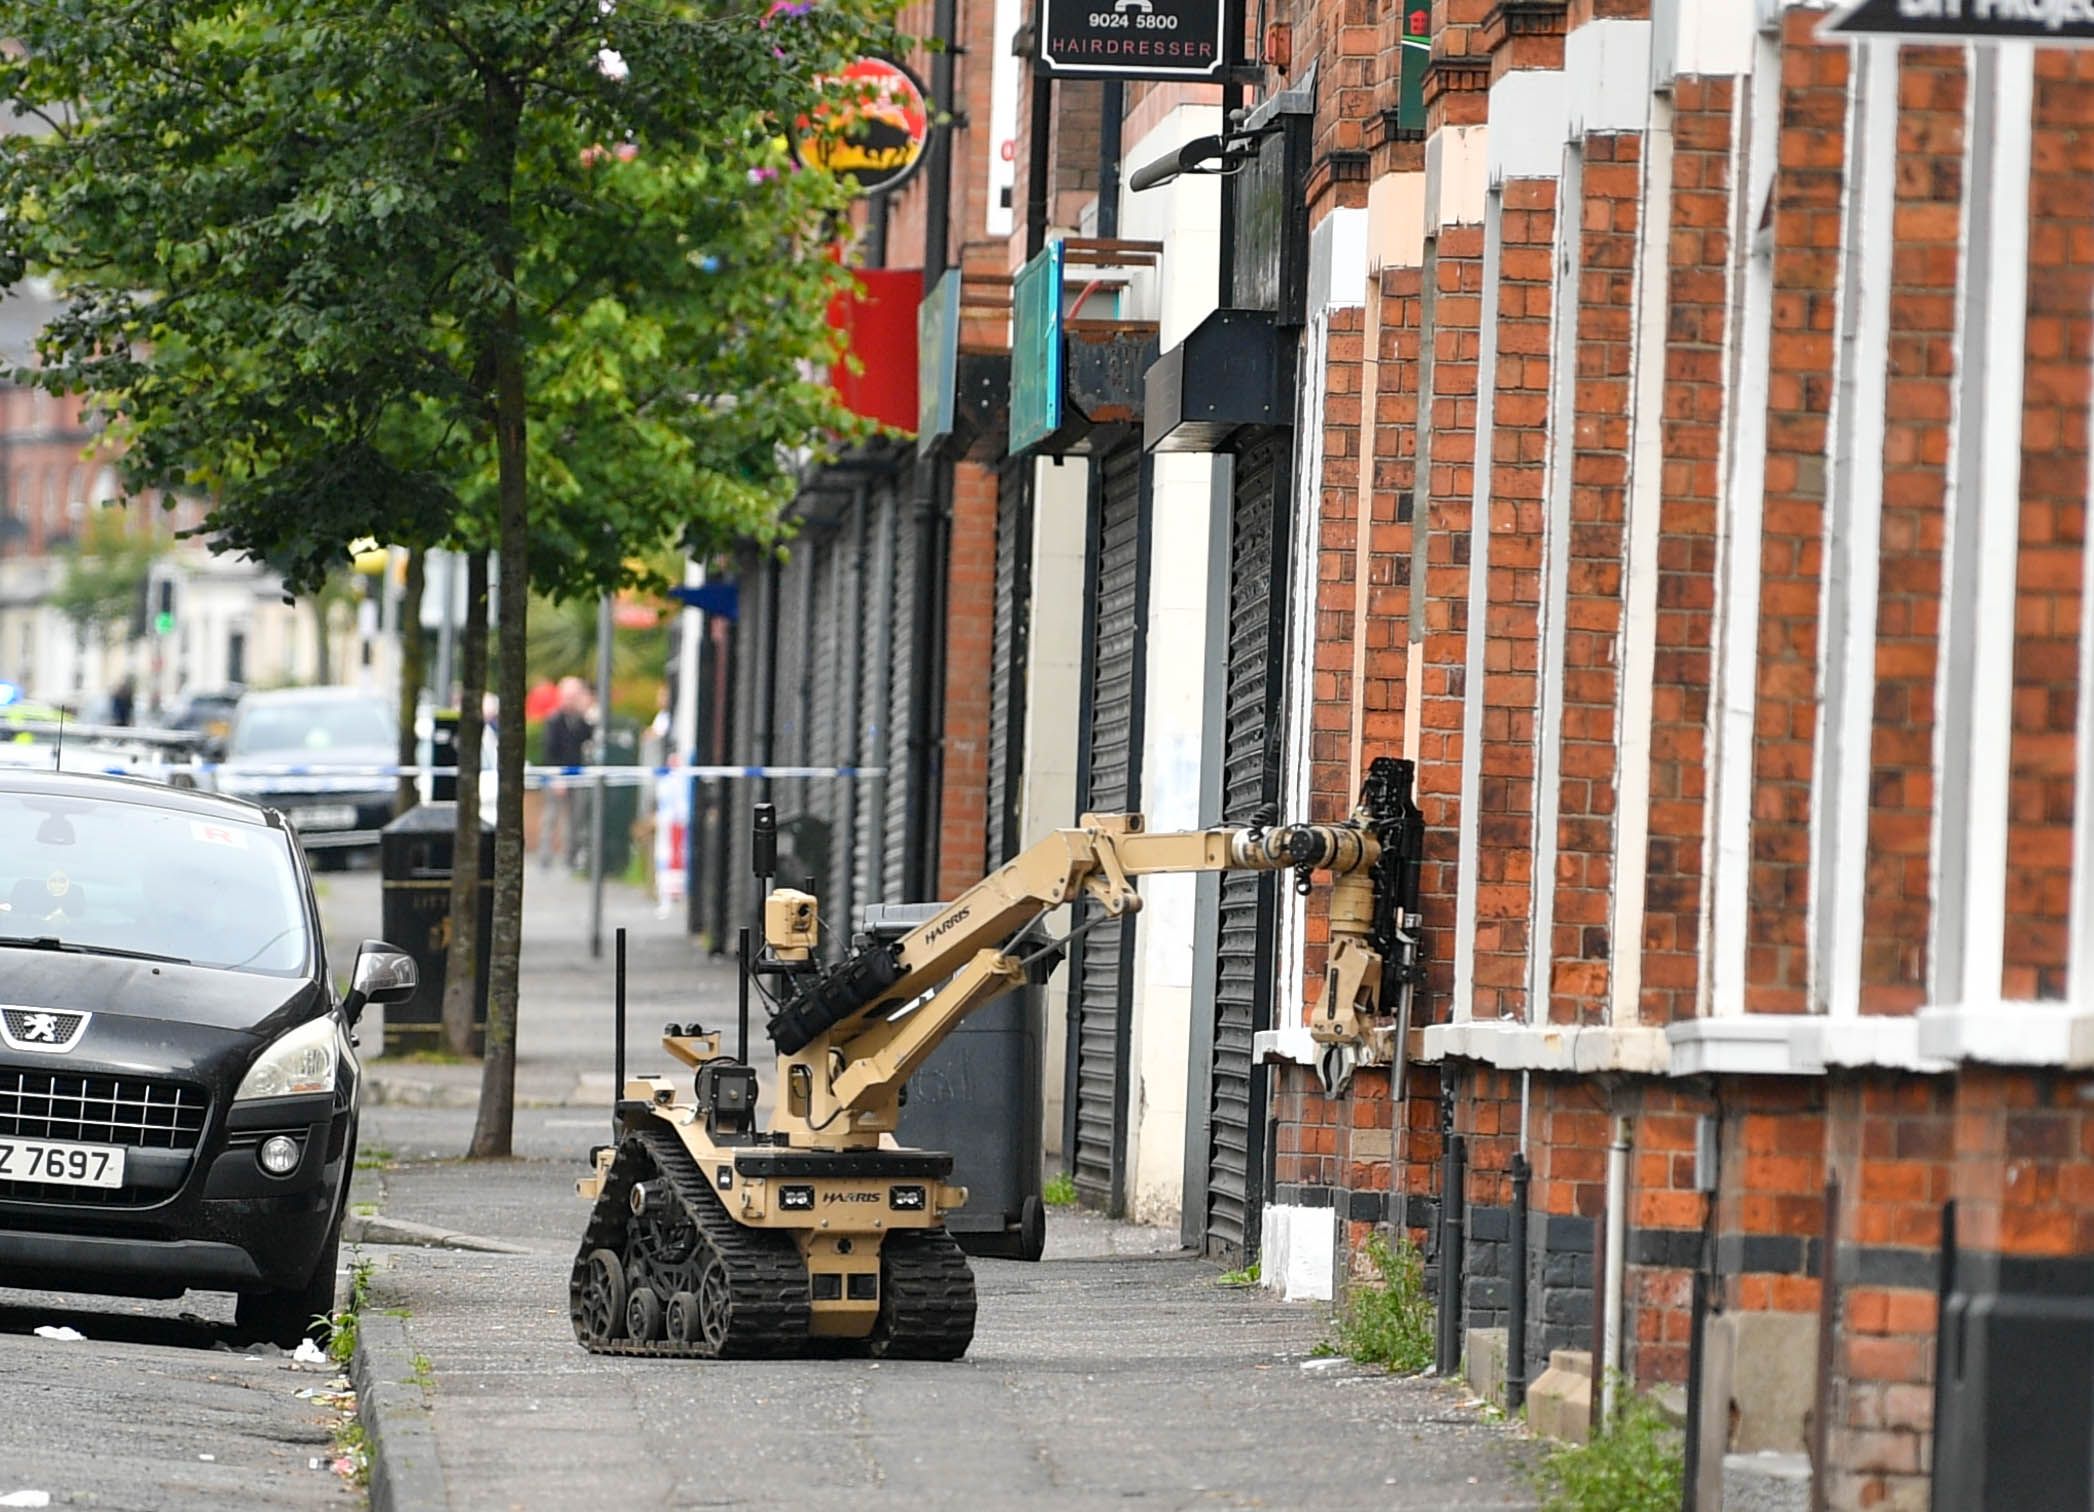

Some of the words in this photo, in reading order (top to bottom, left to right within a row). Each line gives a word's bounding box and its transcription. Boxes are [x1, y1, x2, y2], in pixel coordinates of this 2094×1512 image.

[1088, 13, 1129, 28] 9024
[1135, 14, 1178, 30] 5800
[1052, 38, 1212, 57] HAIRDRESSER
[925, 904, 972, 946] HARRIS
[25, 1146, 110, 1181] 7697
